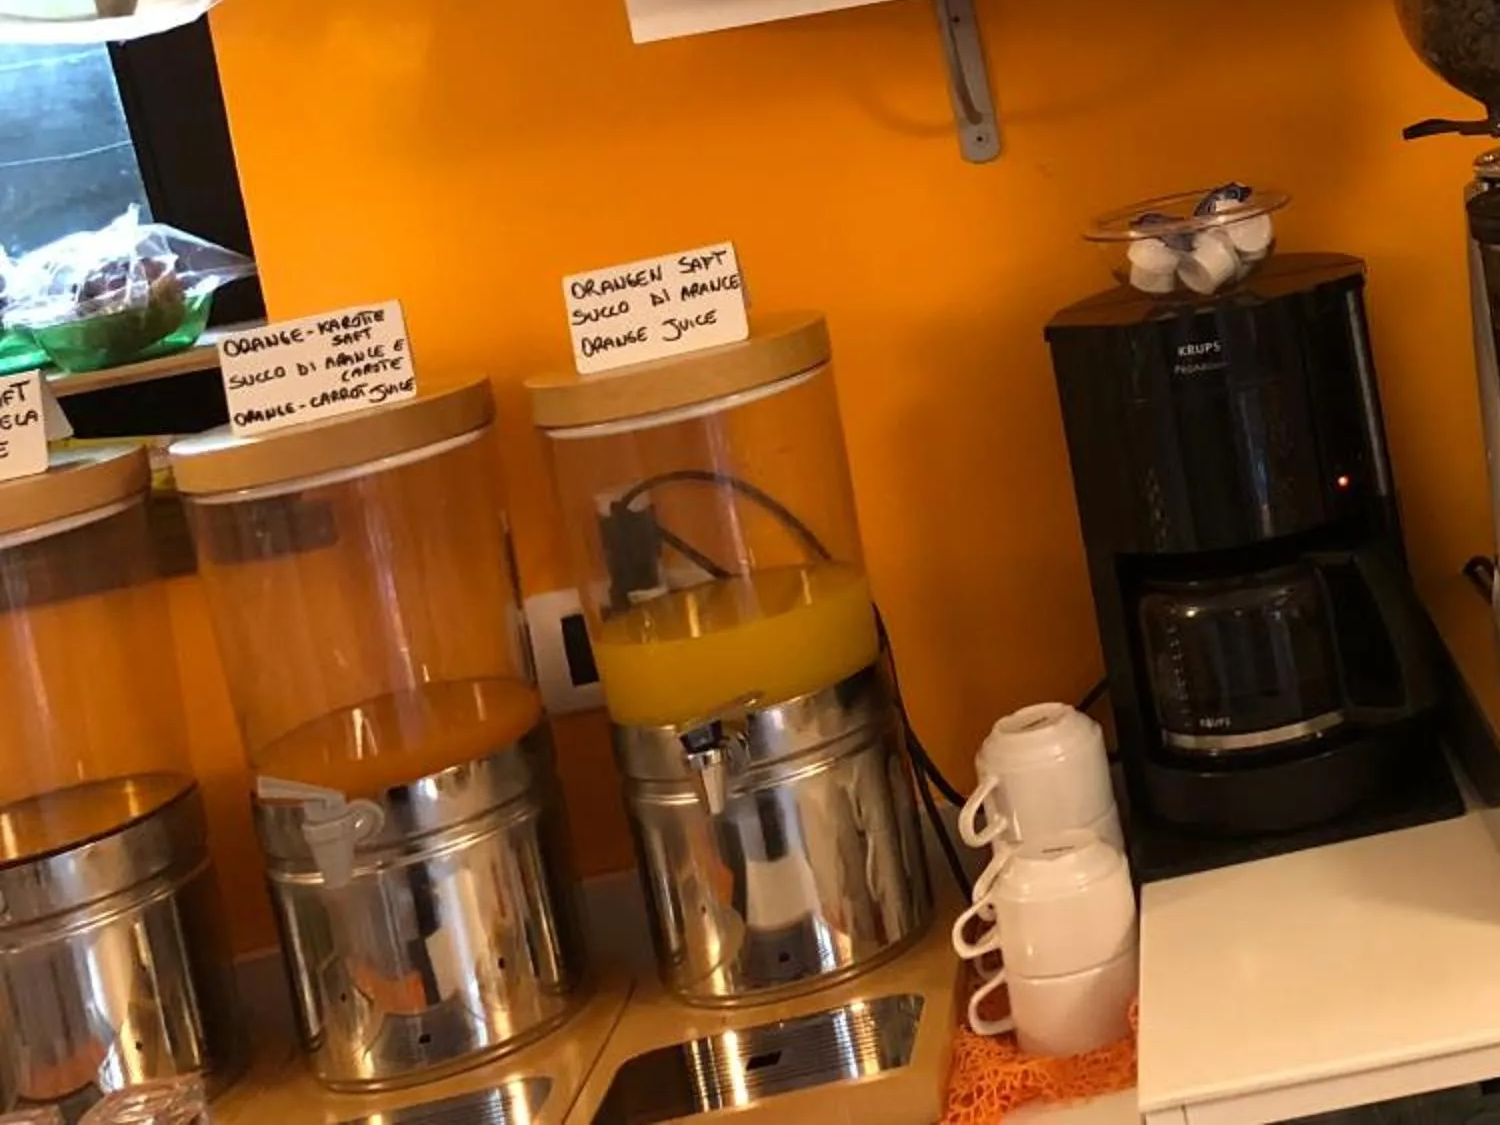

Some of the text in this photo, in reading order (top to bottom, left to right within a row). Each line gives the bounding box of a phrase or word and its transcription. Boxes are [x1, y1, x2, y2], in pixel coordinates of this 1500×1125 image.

[571, 265, 664, 300] ORANGEN
[572, 273, 740, 326] SUCCO DI ARANCE
[331, 327, 373, 347] SAFT
[581, 309, 718, 358] ORANGE JUICE
[1177, 341, 1222, 357] KRUPS
[229, 338, 405, 390] SUCCO DI ARANCE E
[341, 356, 403, 383] CAROTE
[0, 409, 39, 431] ELA
